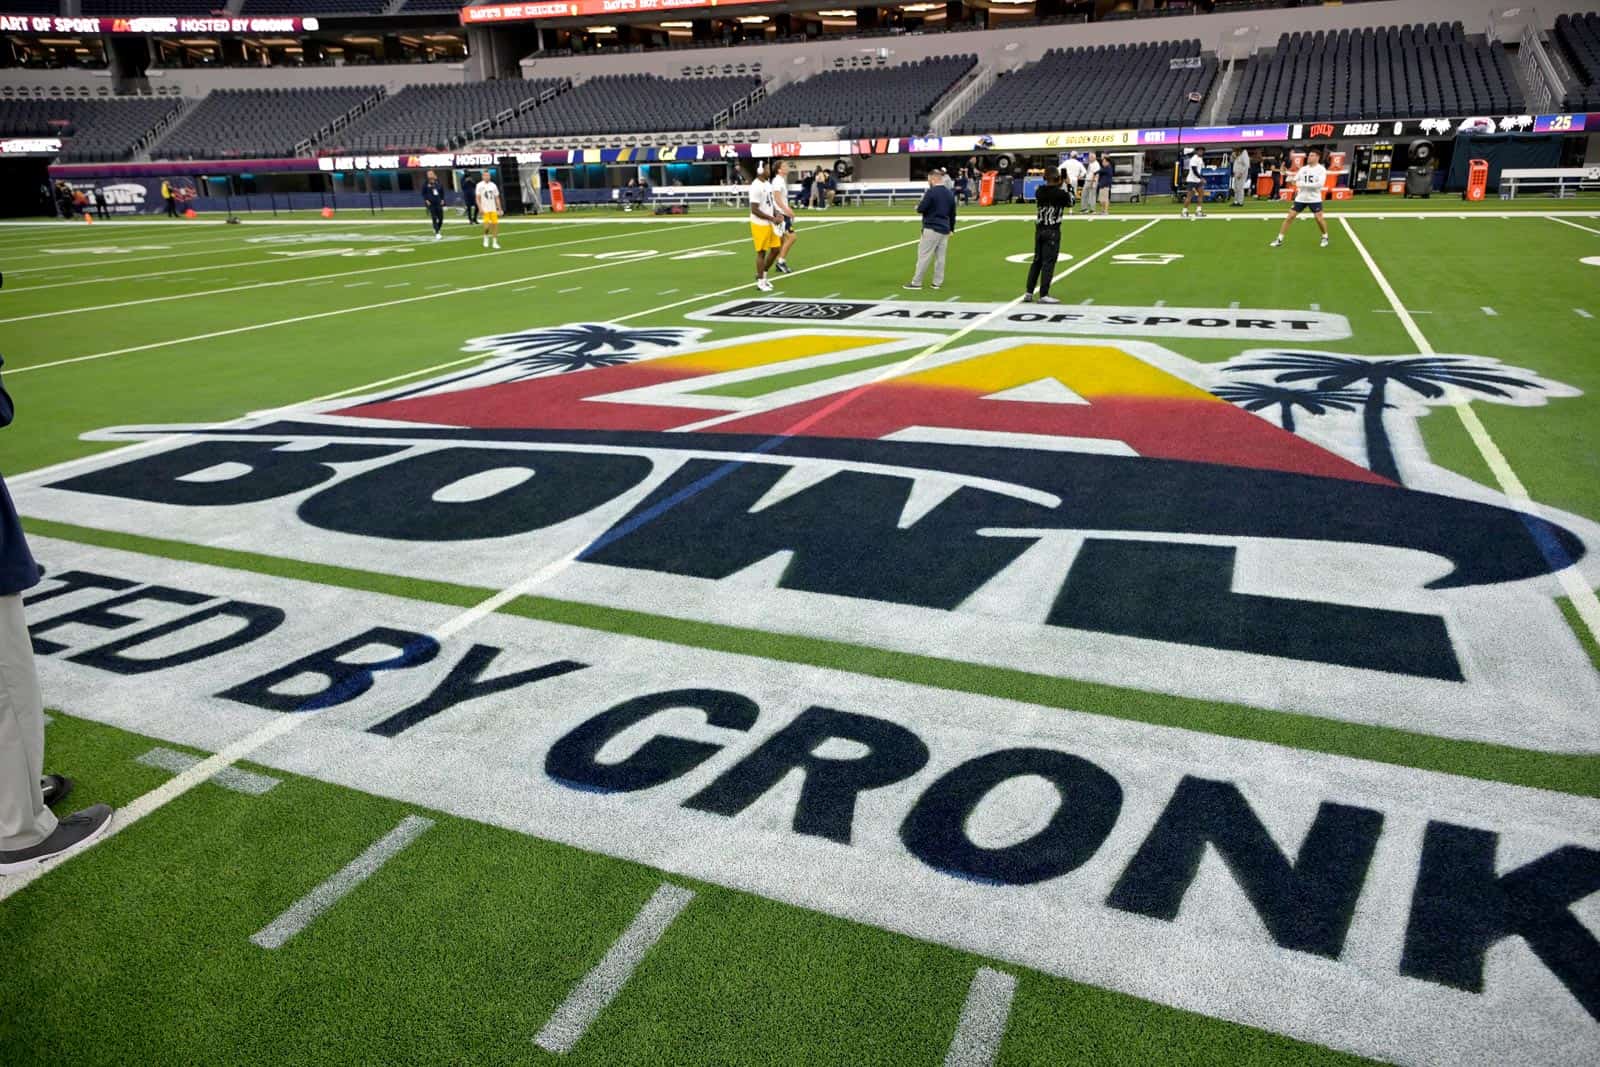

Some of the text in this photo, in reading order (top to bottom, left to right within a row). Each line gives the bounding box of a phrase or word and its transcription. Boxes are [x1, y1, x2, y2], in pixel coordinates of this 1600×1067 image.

[0, 16, 29, 31] ART
[32, 17, 51, 31] OF
[55, 17, 100, 32] SPORT
[181, 18, 230, 32] HOSTED
[232, 18, 249, 32] BY
[1310, 124, 1335, 138] UNLV
[1343, 123, 1380, 136] REBELS
[1549, 115, 1572, 131] :25
[455, 154, 493, 166] HOSTED
[873, 309, 993, 320] ART
[1007, 313, 1084, 323] OF
[1102, 315, 1319, 330] SPORT
[328, 333, 1402, 487] LA
[40, 439, 1466, 683] BOWL
[22, 570, 1600, 1023] TED BY GRONK
